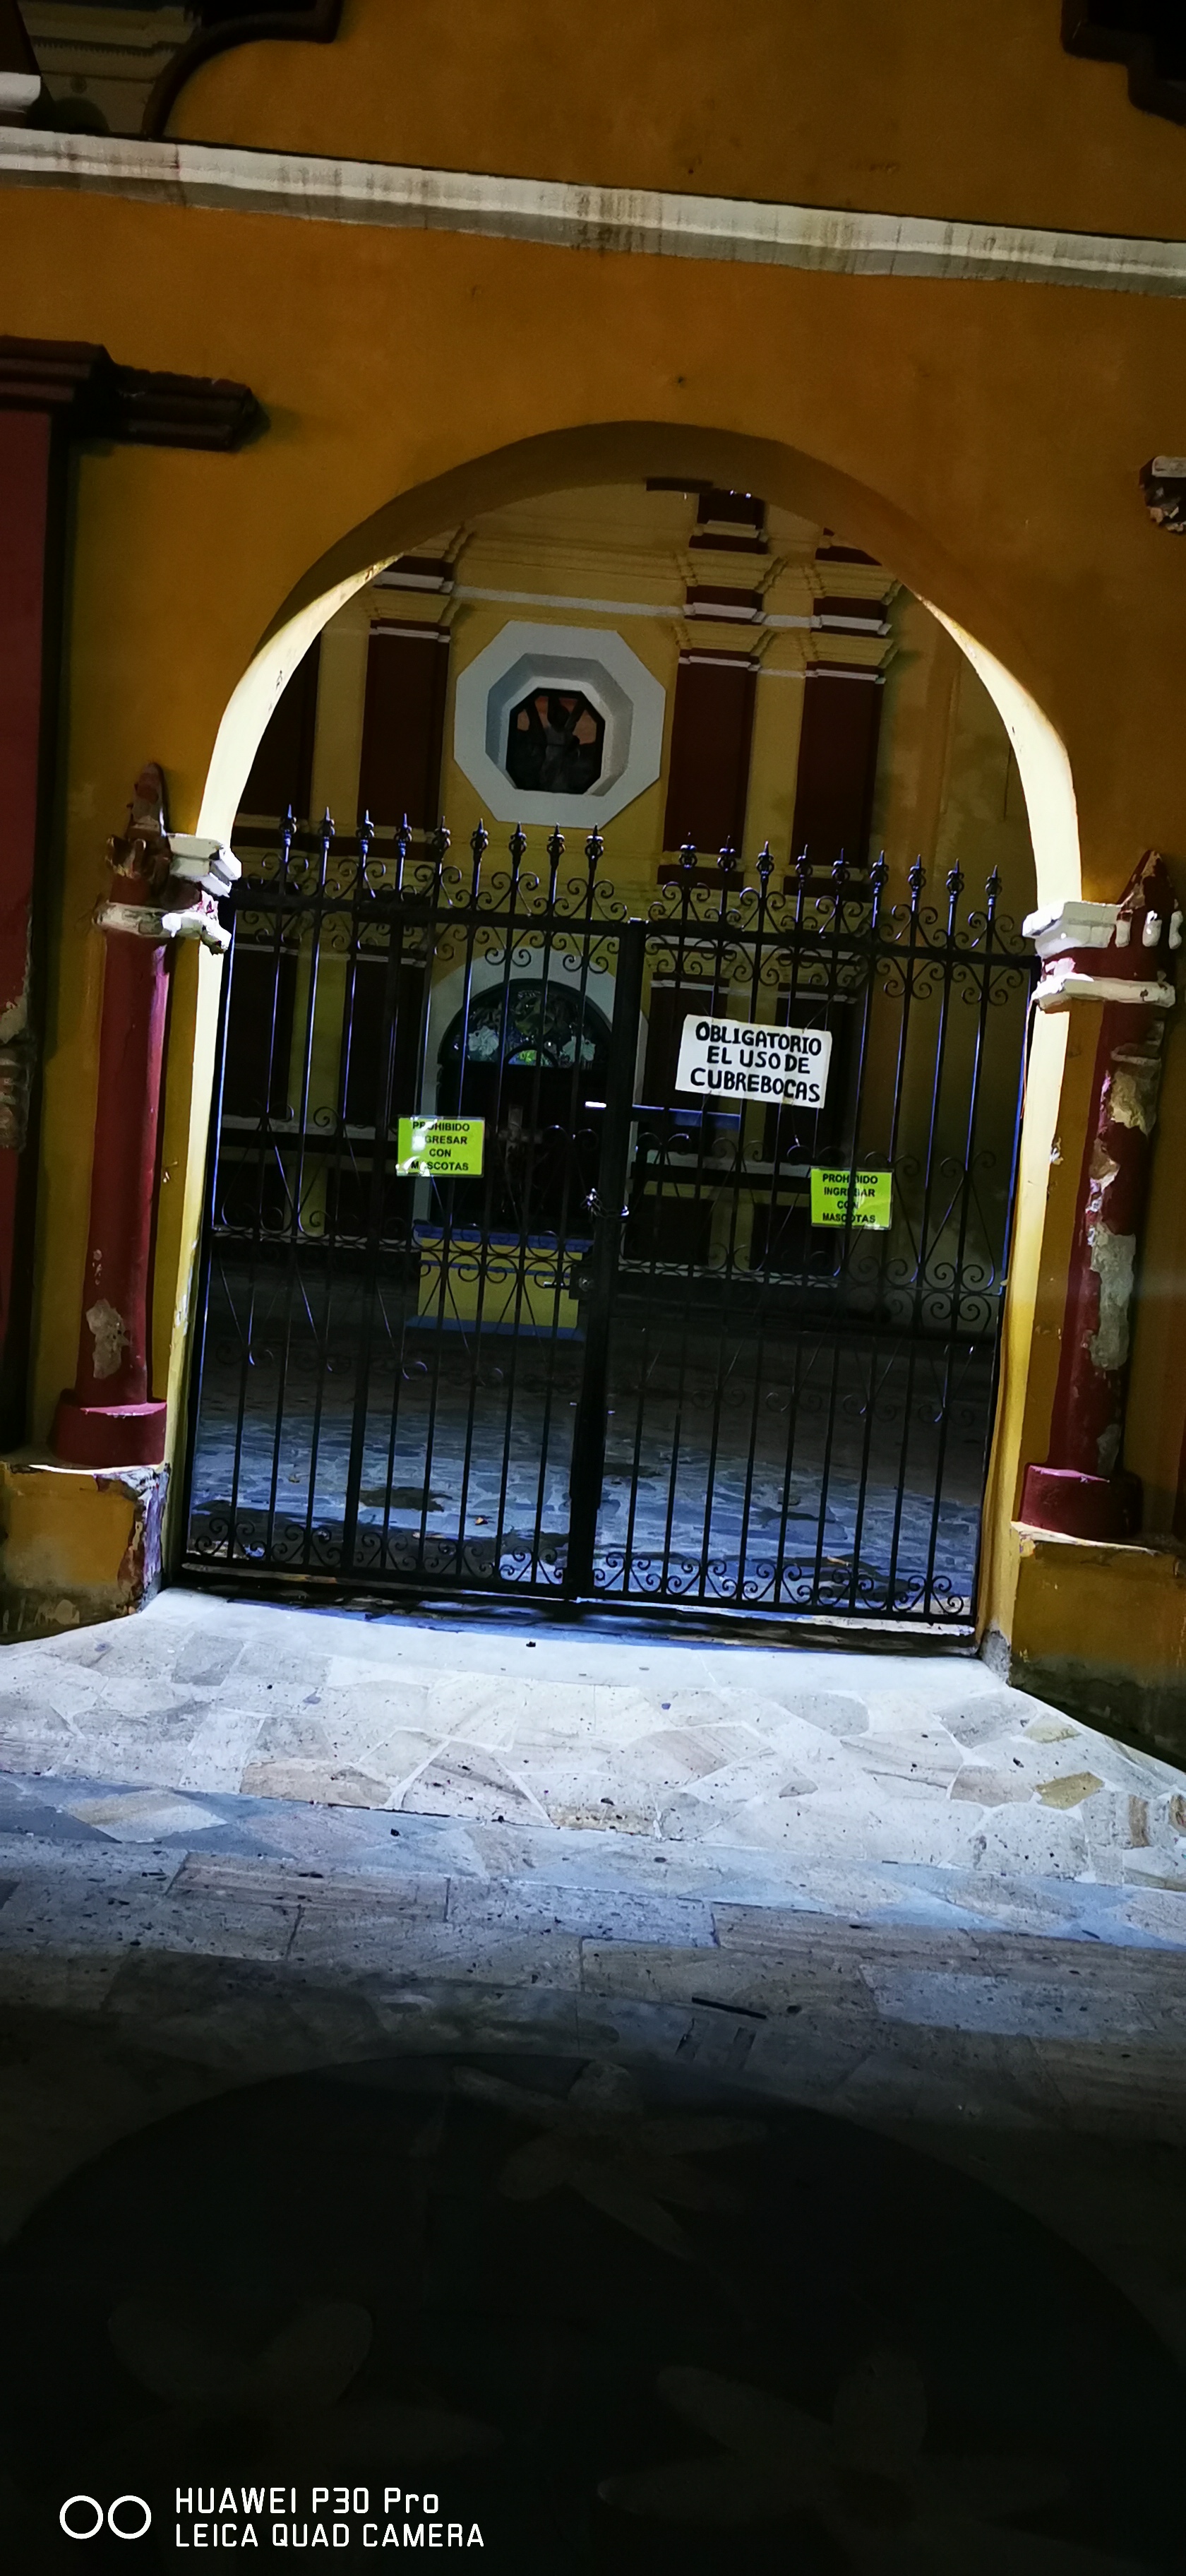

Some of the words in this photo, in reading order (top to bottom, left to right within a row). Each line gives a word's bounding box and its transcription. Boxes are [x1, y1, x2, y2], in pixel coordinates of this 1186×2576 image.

[695, 1021, 822, 1056] OBLIGATORIO
[707, 1046, 732, 1064] EL
[740, 1049, 781, 1069] USO
[785, 1054, 810, 1074] DE
[690, 1068, 820, 1102] CUBREBOCAS
[414, 1135, 467, 1144] GRESAR
[411, 1161, 469, 1170] MSCOTAS
[822, 1174, 877, 1183] PROHIDO
[824, 1186, 875, 1197] INGRSAR
